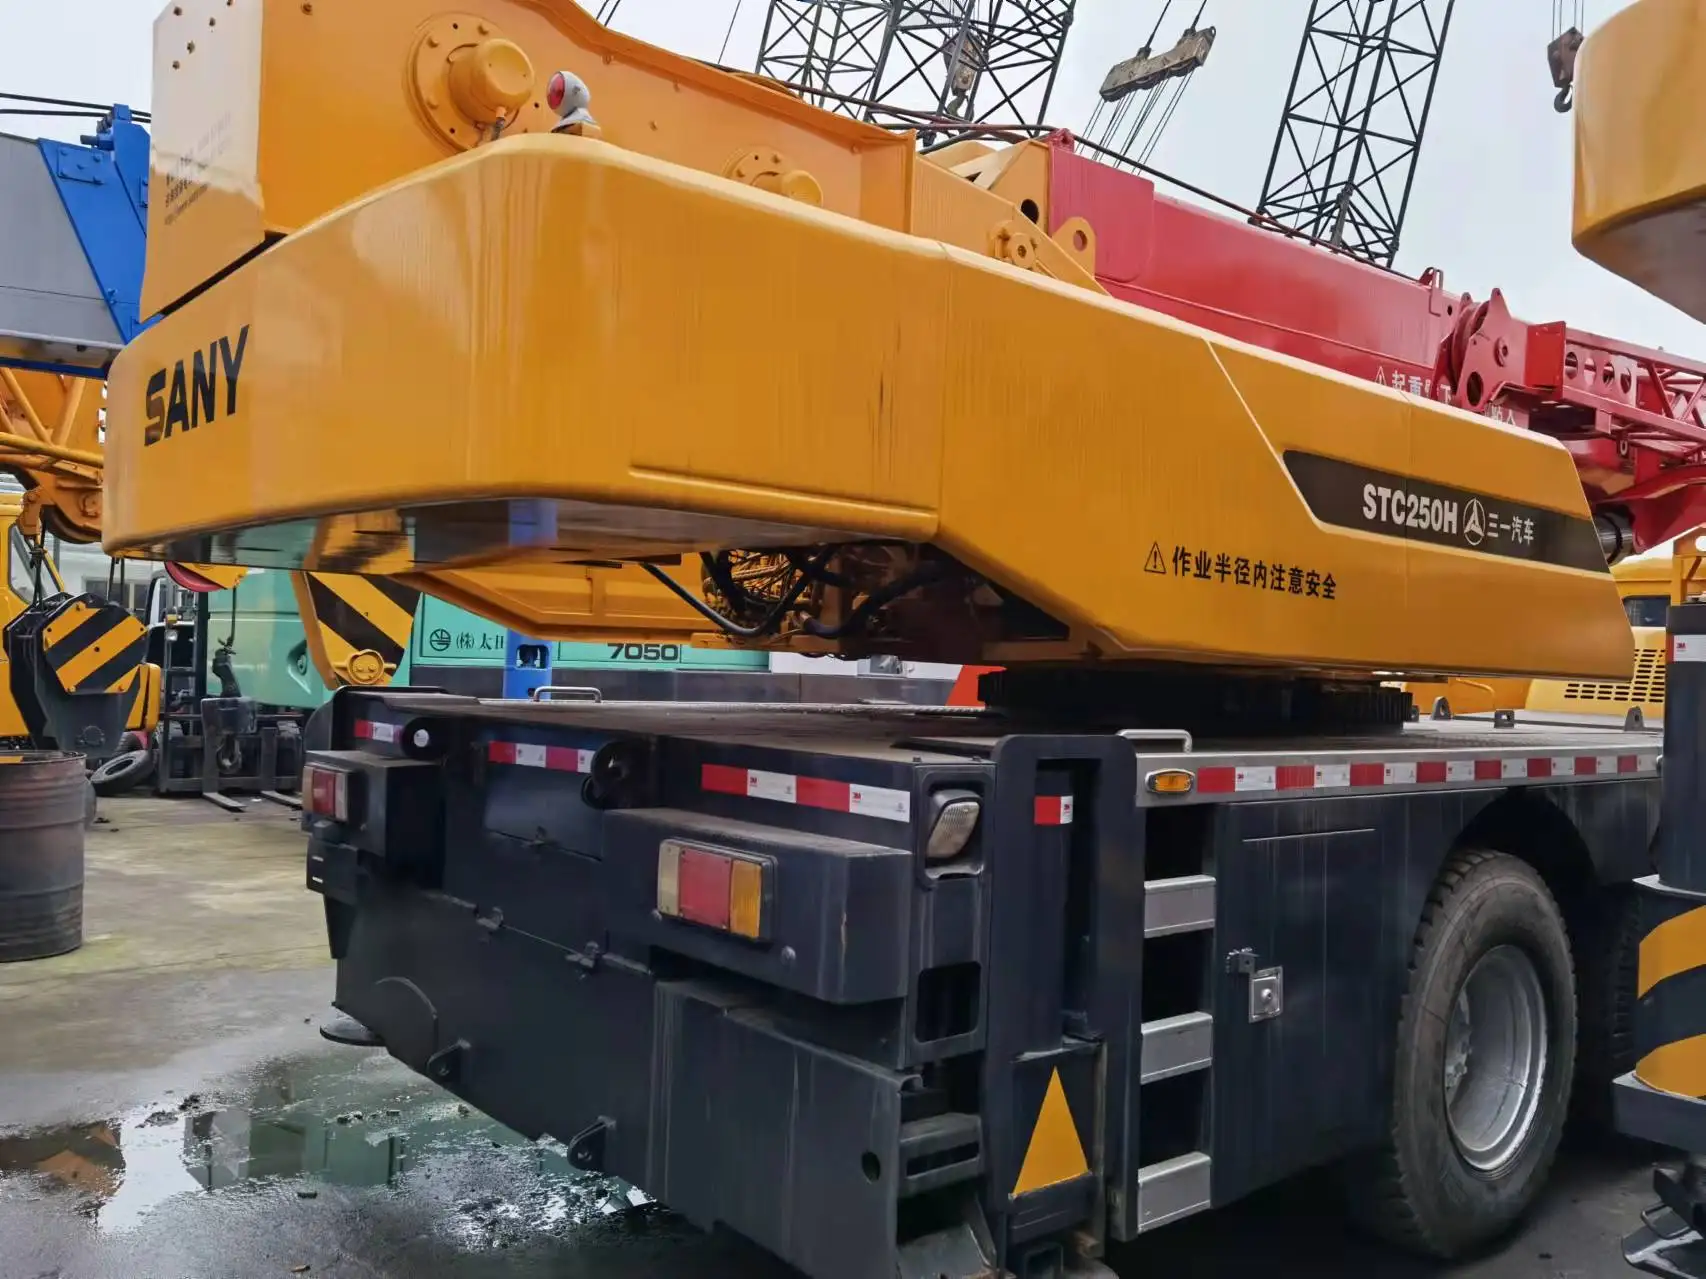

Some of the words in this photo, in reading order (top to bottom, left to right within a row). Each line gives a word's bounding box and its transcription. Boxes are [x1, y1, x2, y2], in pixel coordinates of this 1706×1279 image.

[144, 324, 250, 447] SANY
[1362, 483, 1458, 535] STC250H
[1487, 514, 1535, 546] 三一汽车
[1172, 545, 1337, 600] 作业半径内注意安全
[607, 643, 679, 660] 7050
